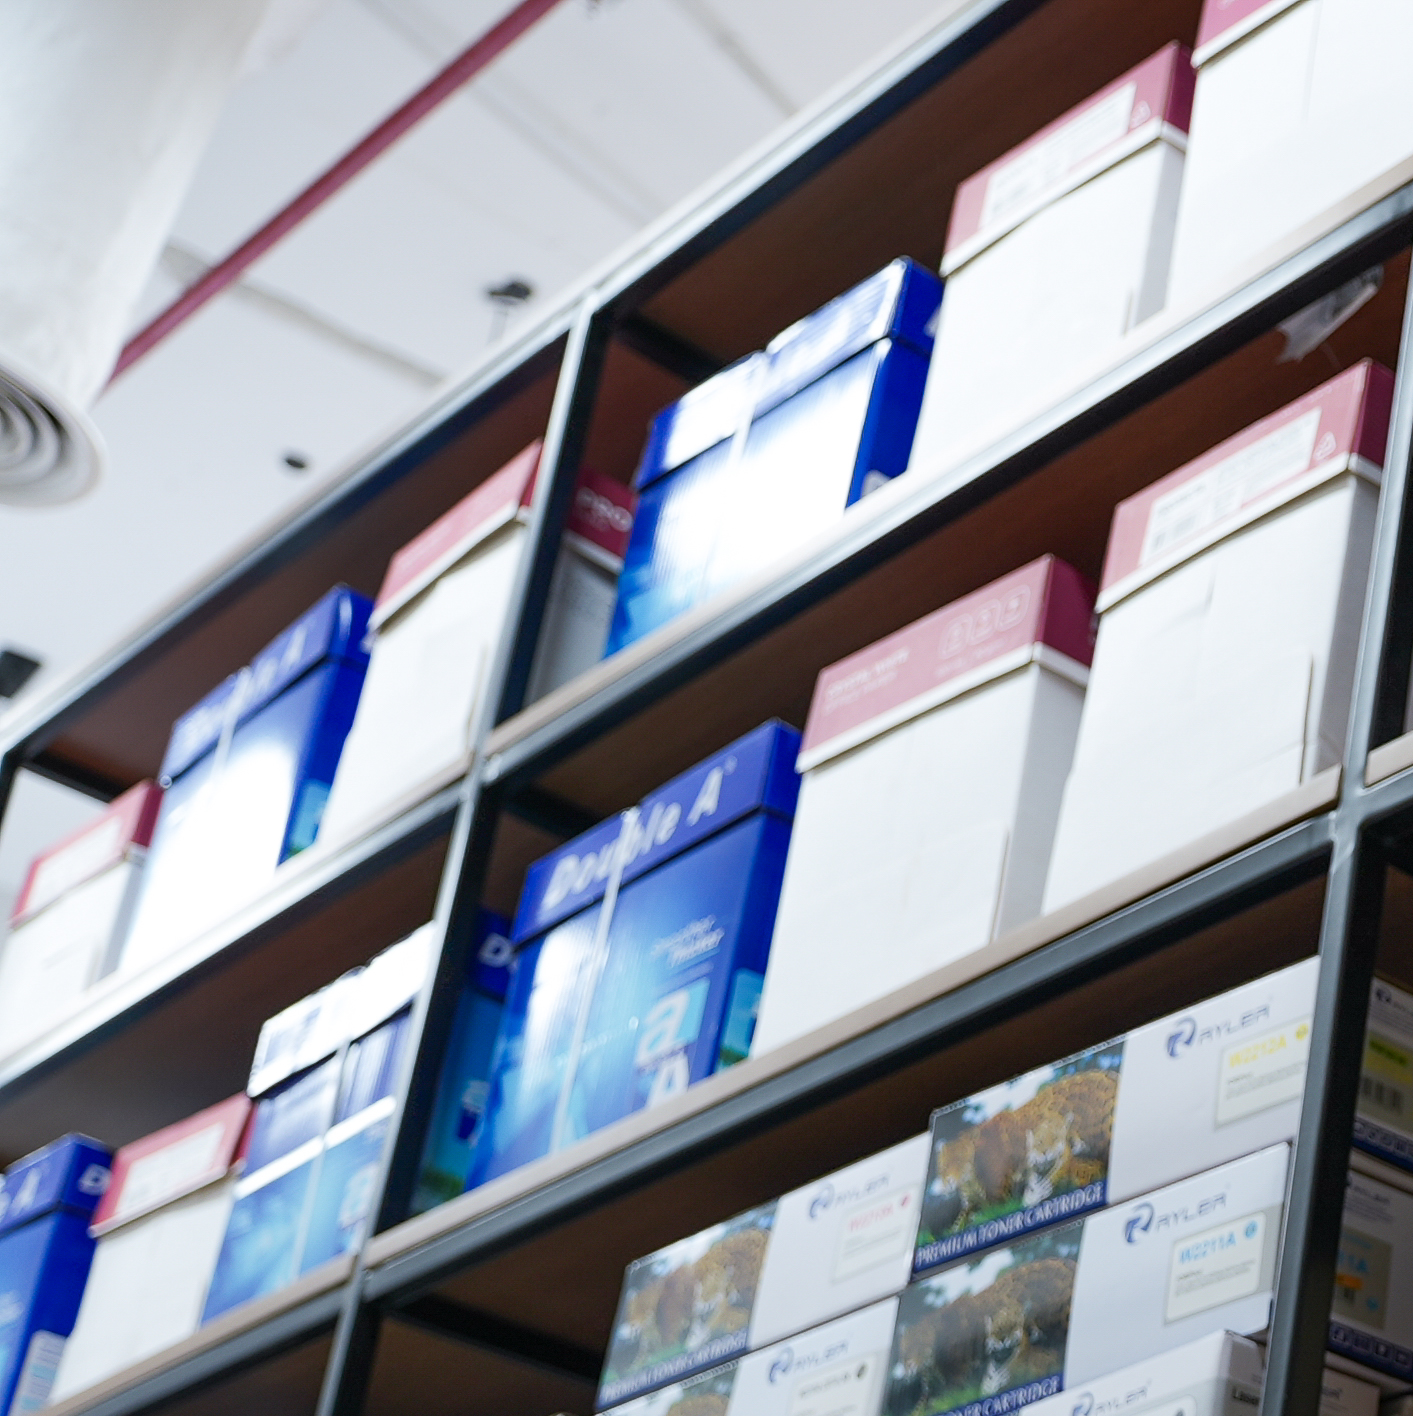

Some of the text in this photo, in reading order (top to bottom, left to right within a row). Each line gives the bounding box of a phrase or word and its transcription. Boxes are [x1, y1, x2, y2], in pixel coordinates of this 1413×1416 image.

[916, 1181, 1105, 1267] PREMIUM TONER CARTRIDGE
